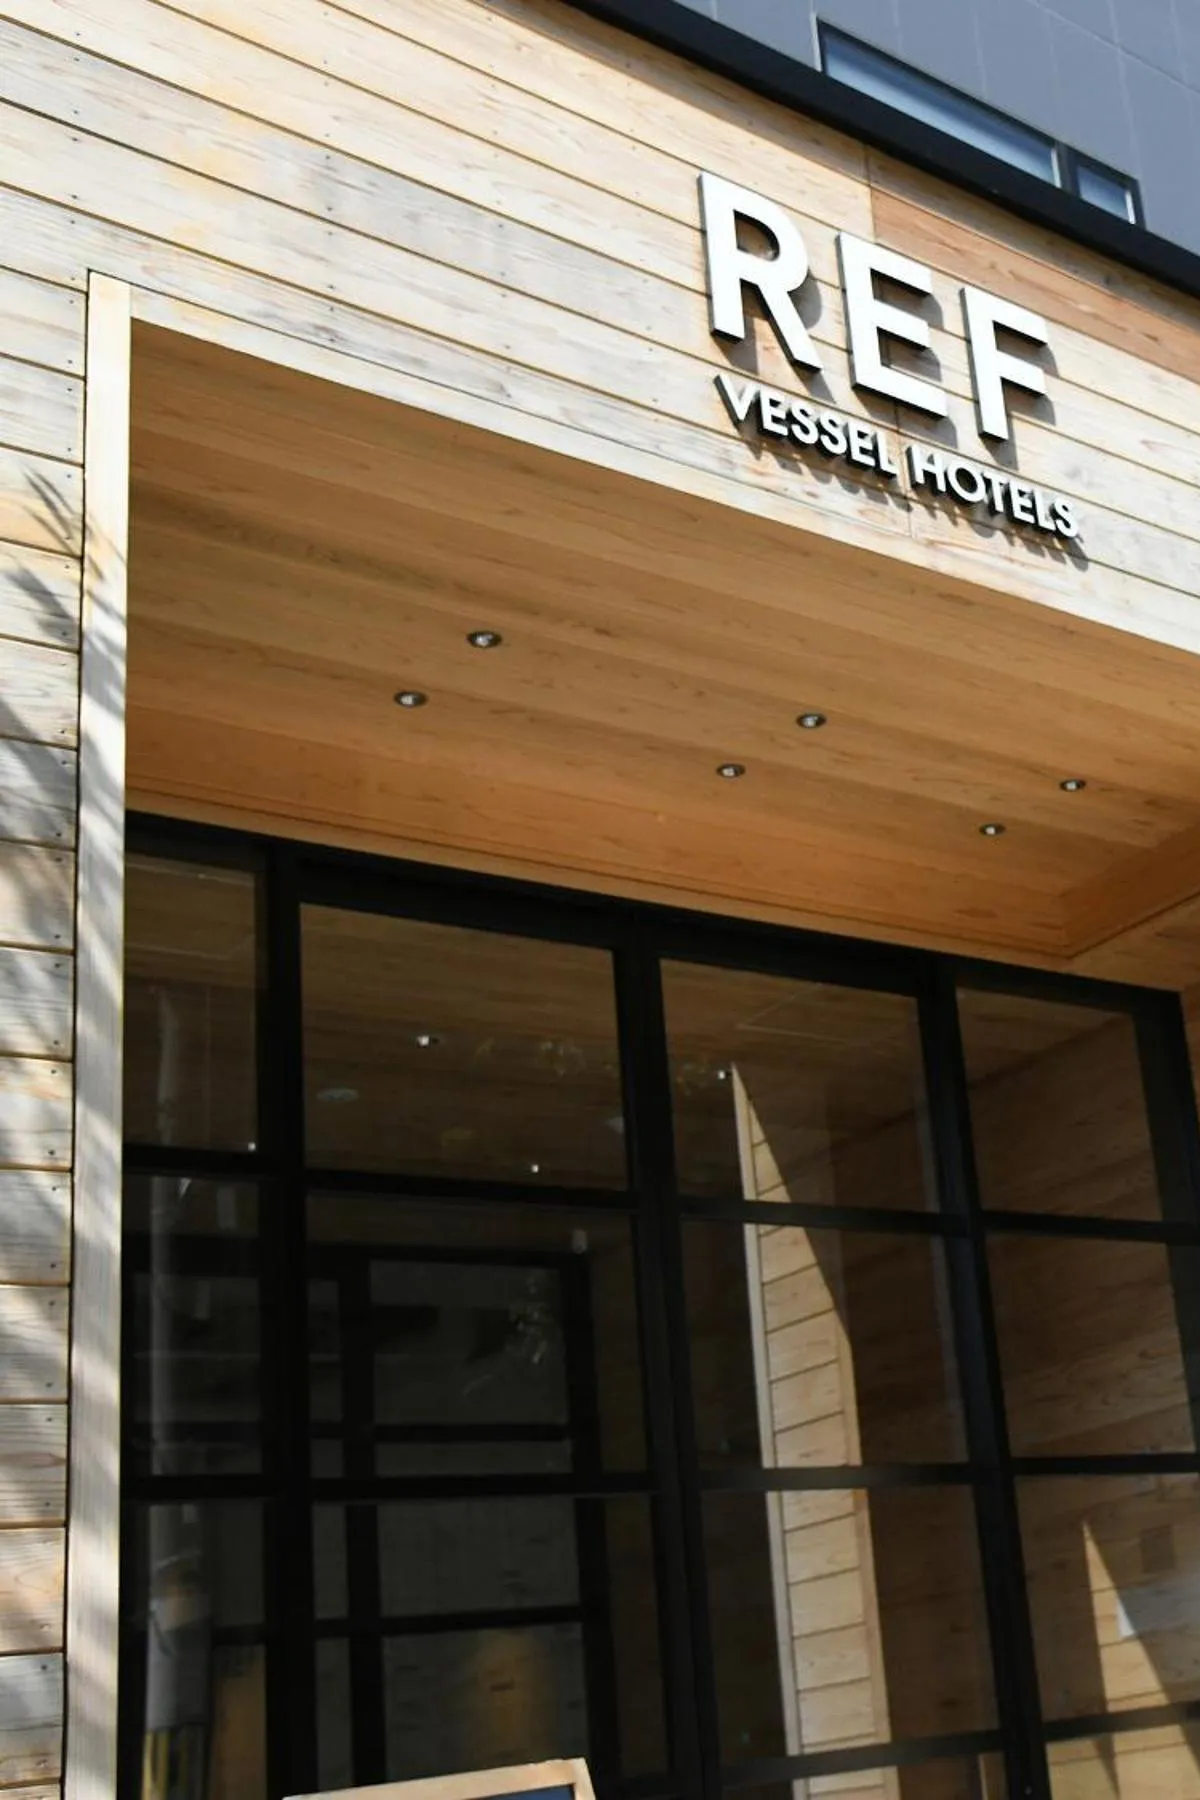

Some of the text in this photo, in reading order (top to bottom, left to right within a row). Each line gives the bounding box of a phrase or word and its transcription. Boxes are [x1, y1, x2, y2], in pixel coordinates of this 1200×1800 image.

[698, 171, 1047, 440] REF
[714, 373, 1080, 538] VESSEL HOTELS
